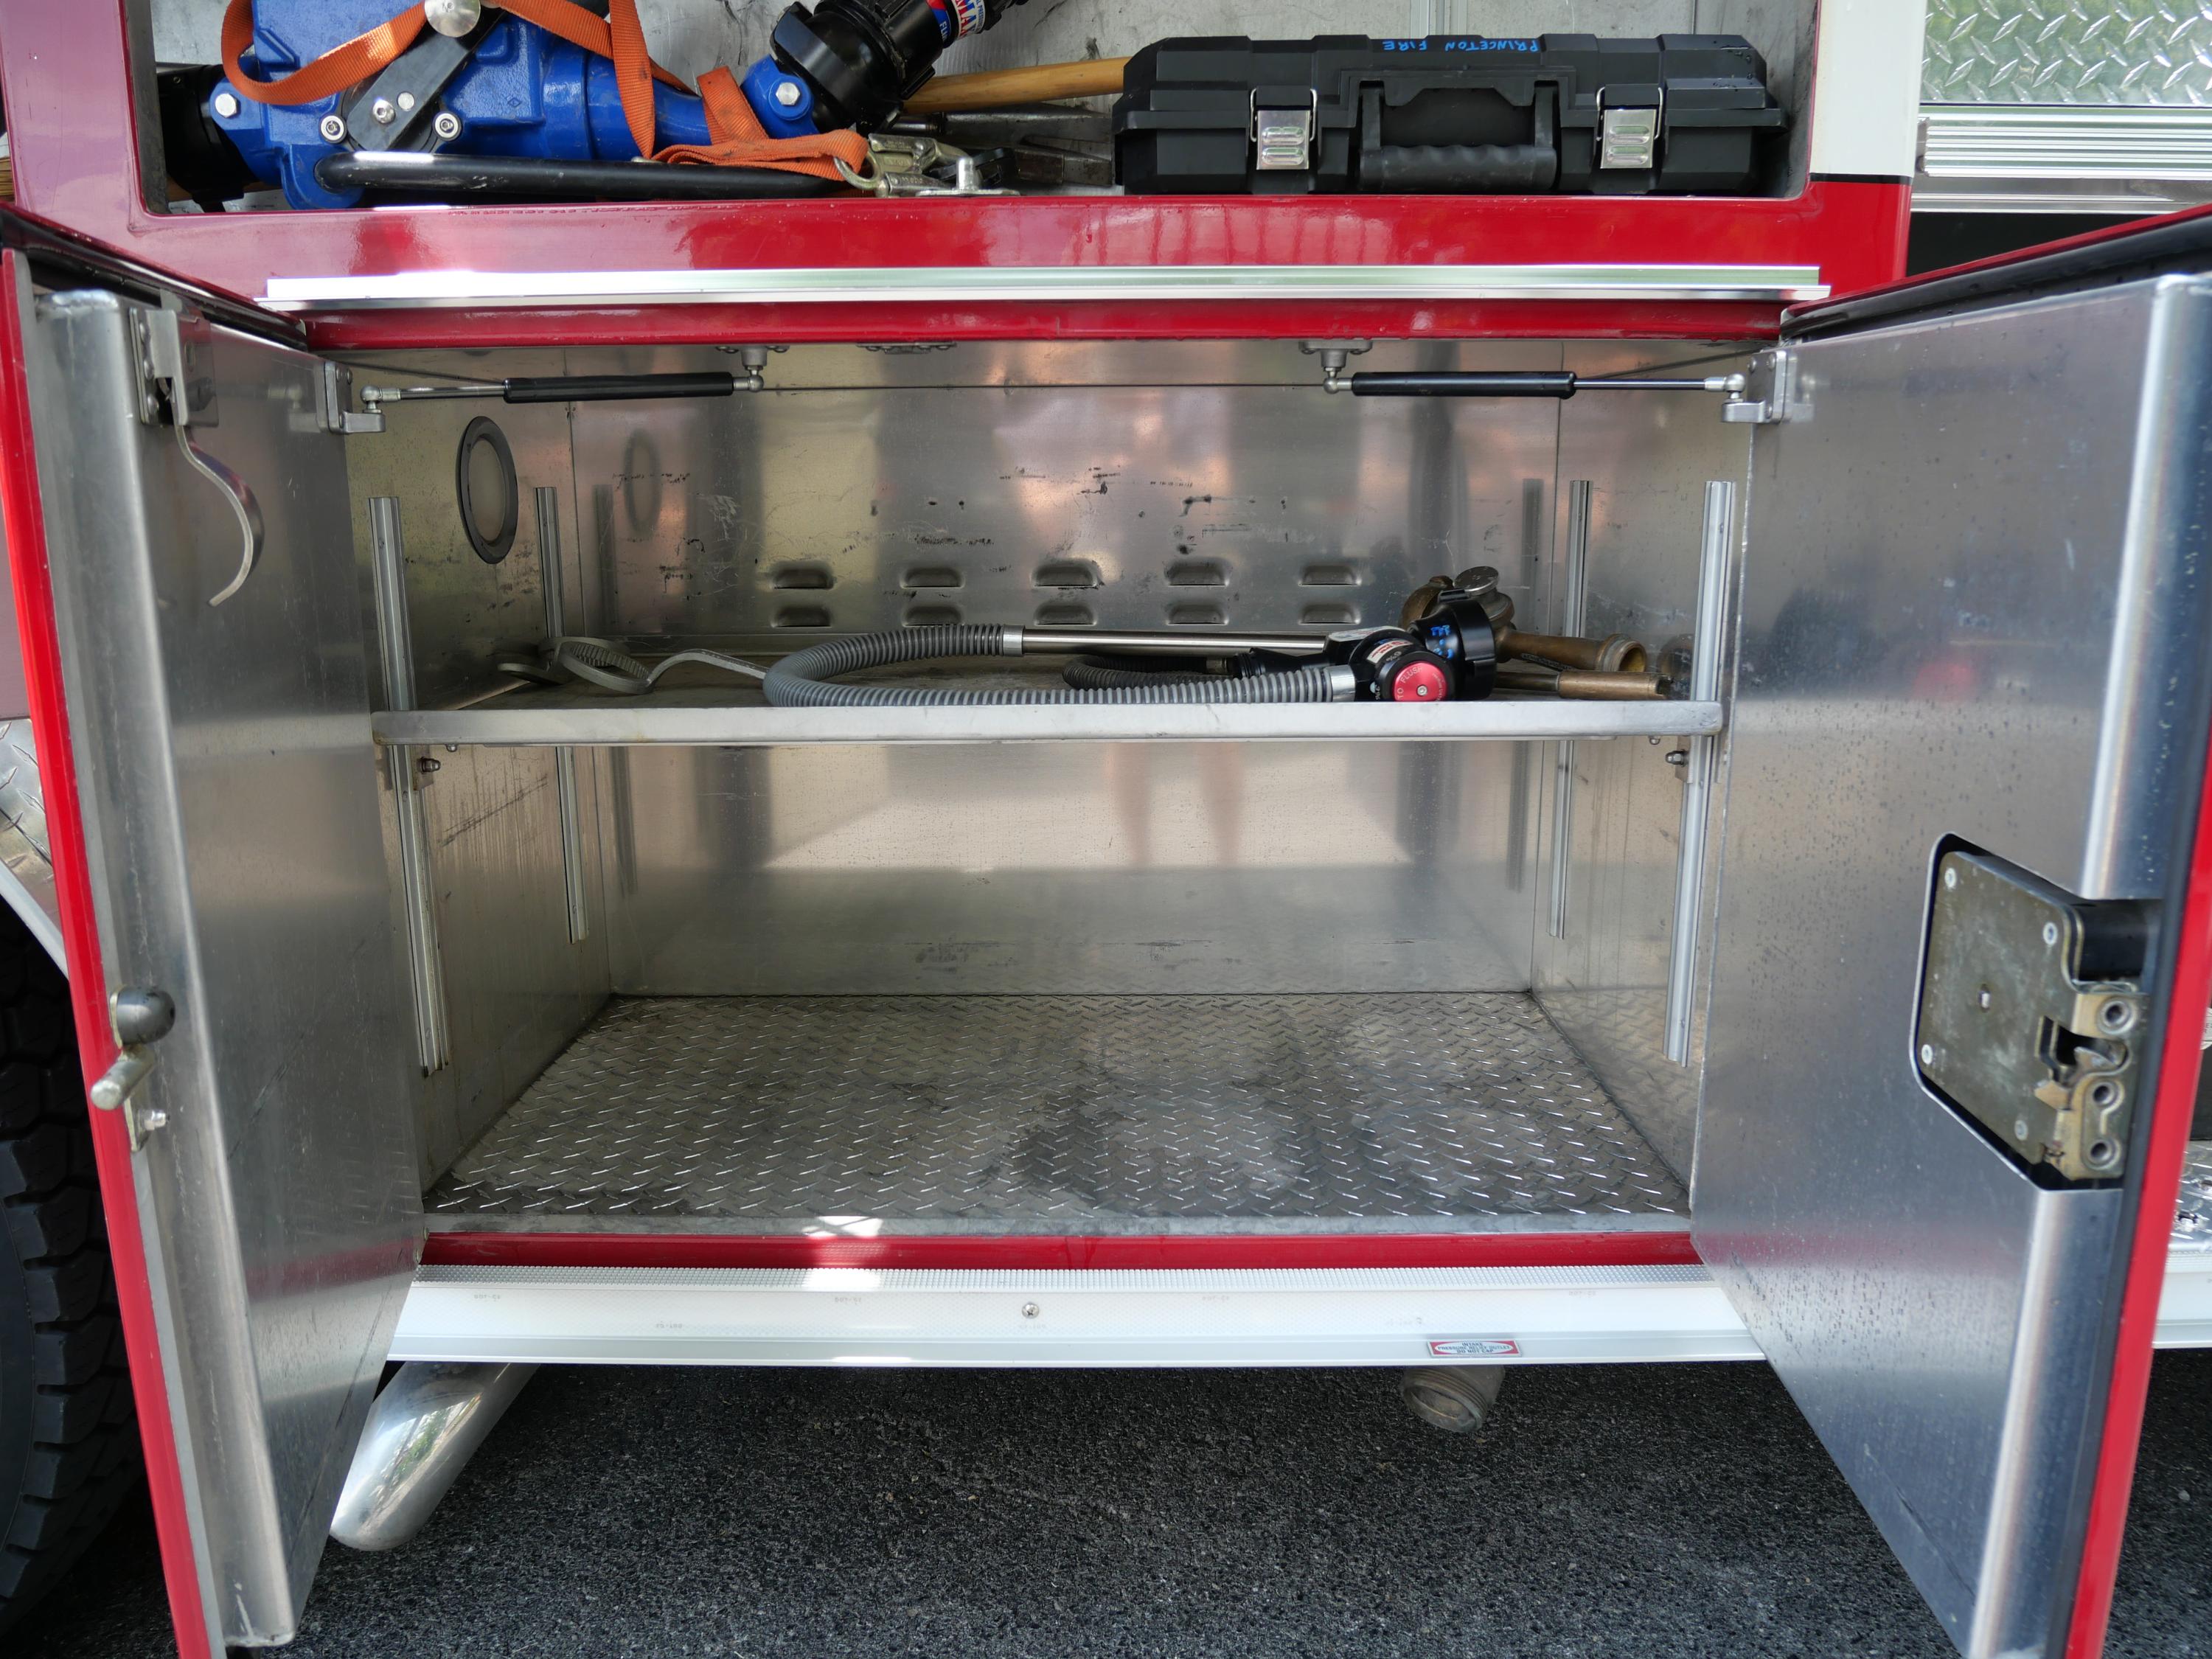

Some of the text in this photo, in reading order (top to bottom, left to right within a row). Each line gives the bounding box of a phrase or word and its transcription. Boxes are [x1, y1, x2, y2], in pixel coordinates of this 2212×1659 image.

[1382, 40, 1540, 52] PRINCETON FIRE
[1399, 667, 1422, 684] FLUSH
